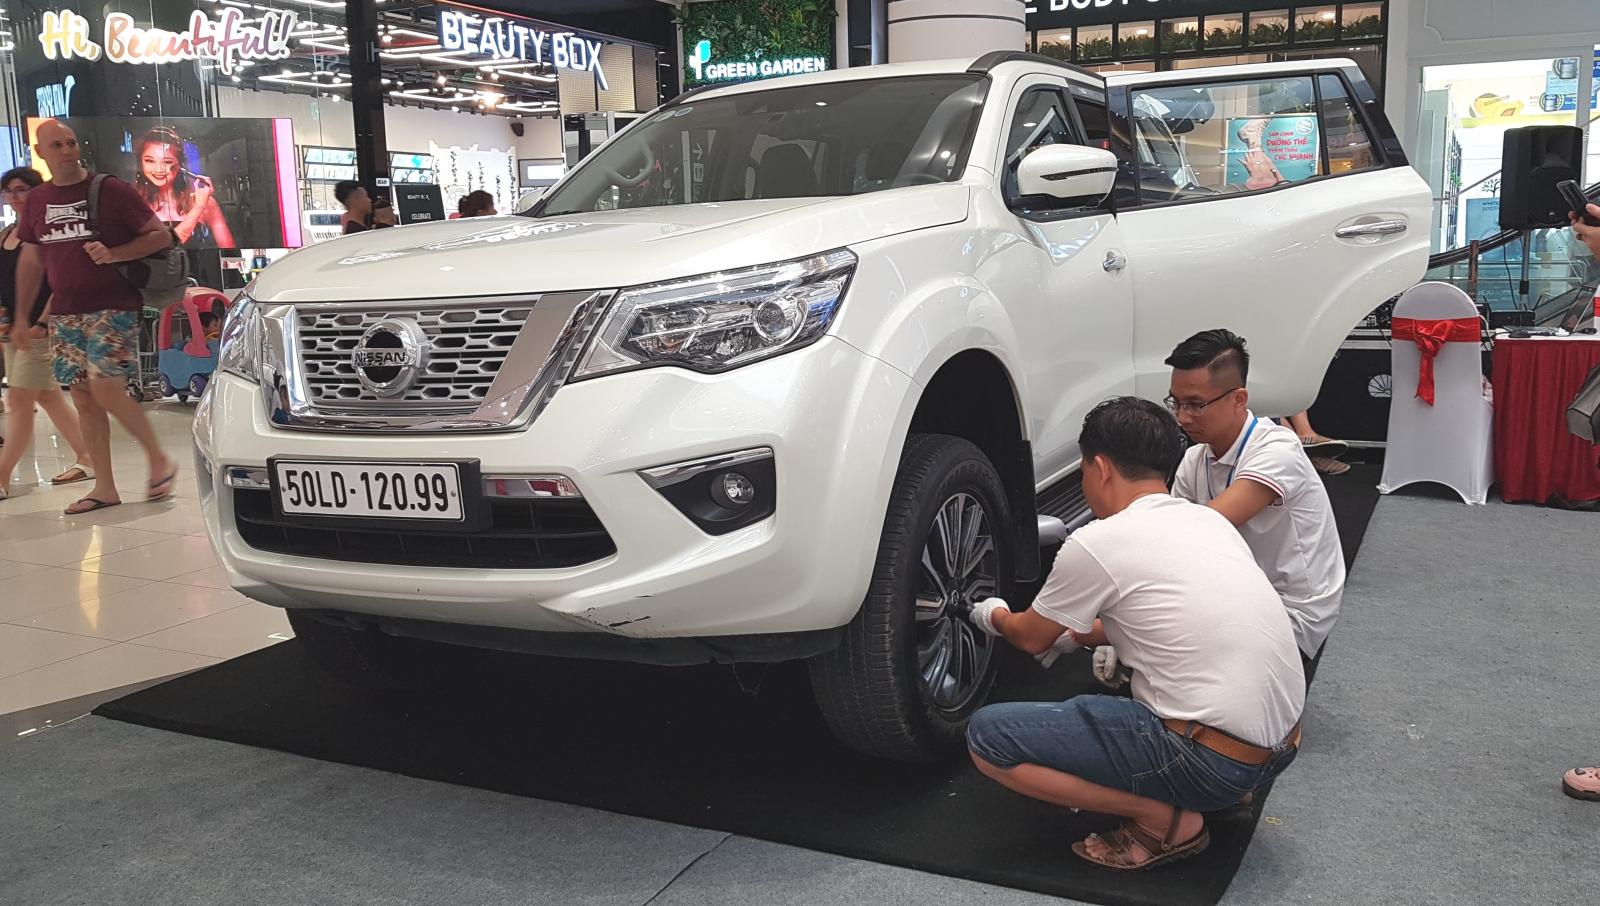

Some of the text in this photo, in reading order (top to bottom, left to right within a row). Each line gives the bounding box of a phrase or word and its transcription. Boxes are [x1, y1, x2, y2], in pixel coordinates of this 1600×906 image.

[40, 8, 295, 74] Hi, Beautiful!
[442, 11, 609, 90] BEAUTY BOX
[706, 57, 825, 78] GREEN GARDEN
[355, 352, 406, 363] NISSAN
[285, 470, 449, 511] 50LD-120.99
